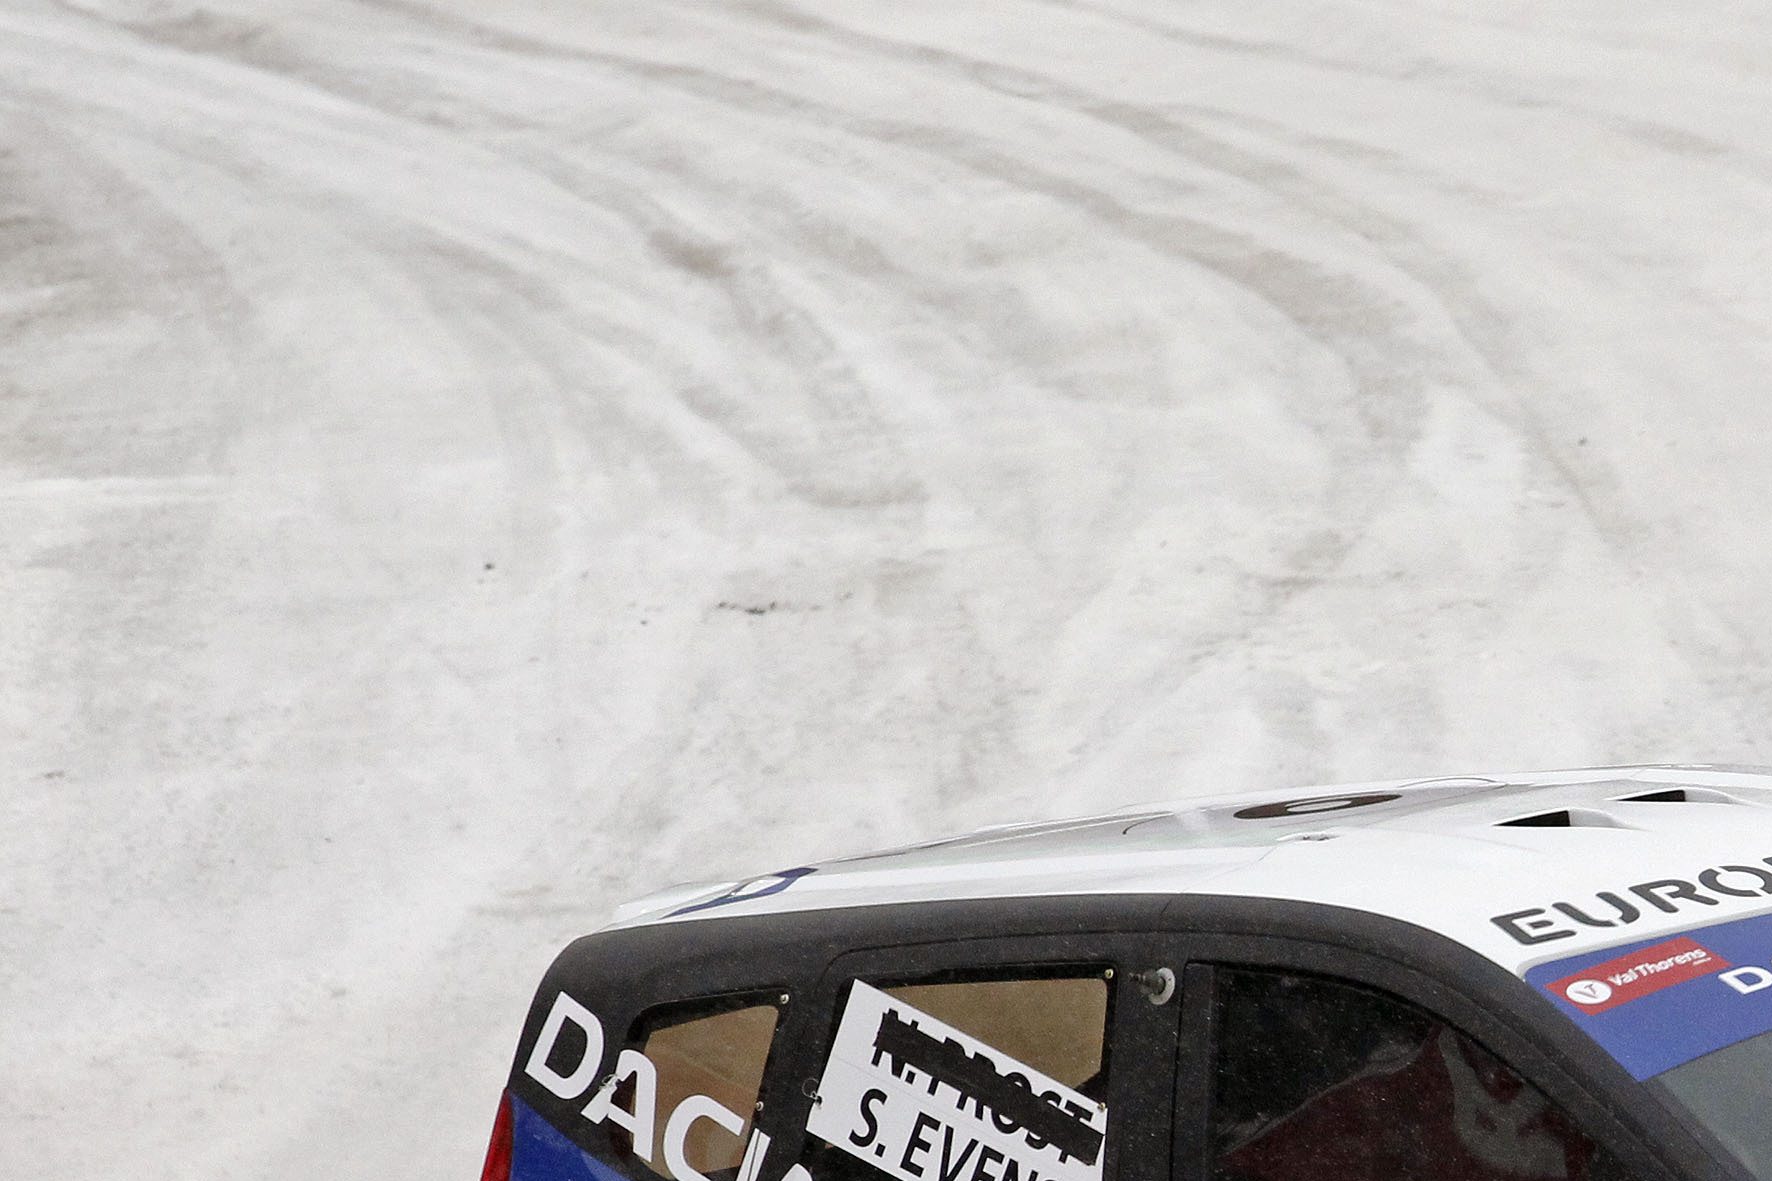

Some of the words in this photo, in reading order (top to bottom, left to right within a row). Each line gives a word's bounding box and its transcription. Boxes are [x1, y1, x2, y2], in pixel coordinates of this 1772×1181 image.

[1608, 969, 1639, 986] Val
[1635, 949, 1707, 977] Thorens
[849, 1088, 888, 1158] S.
